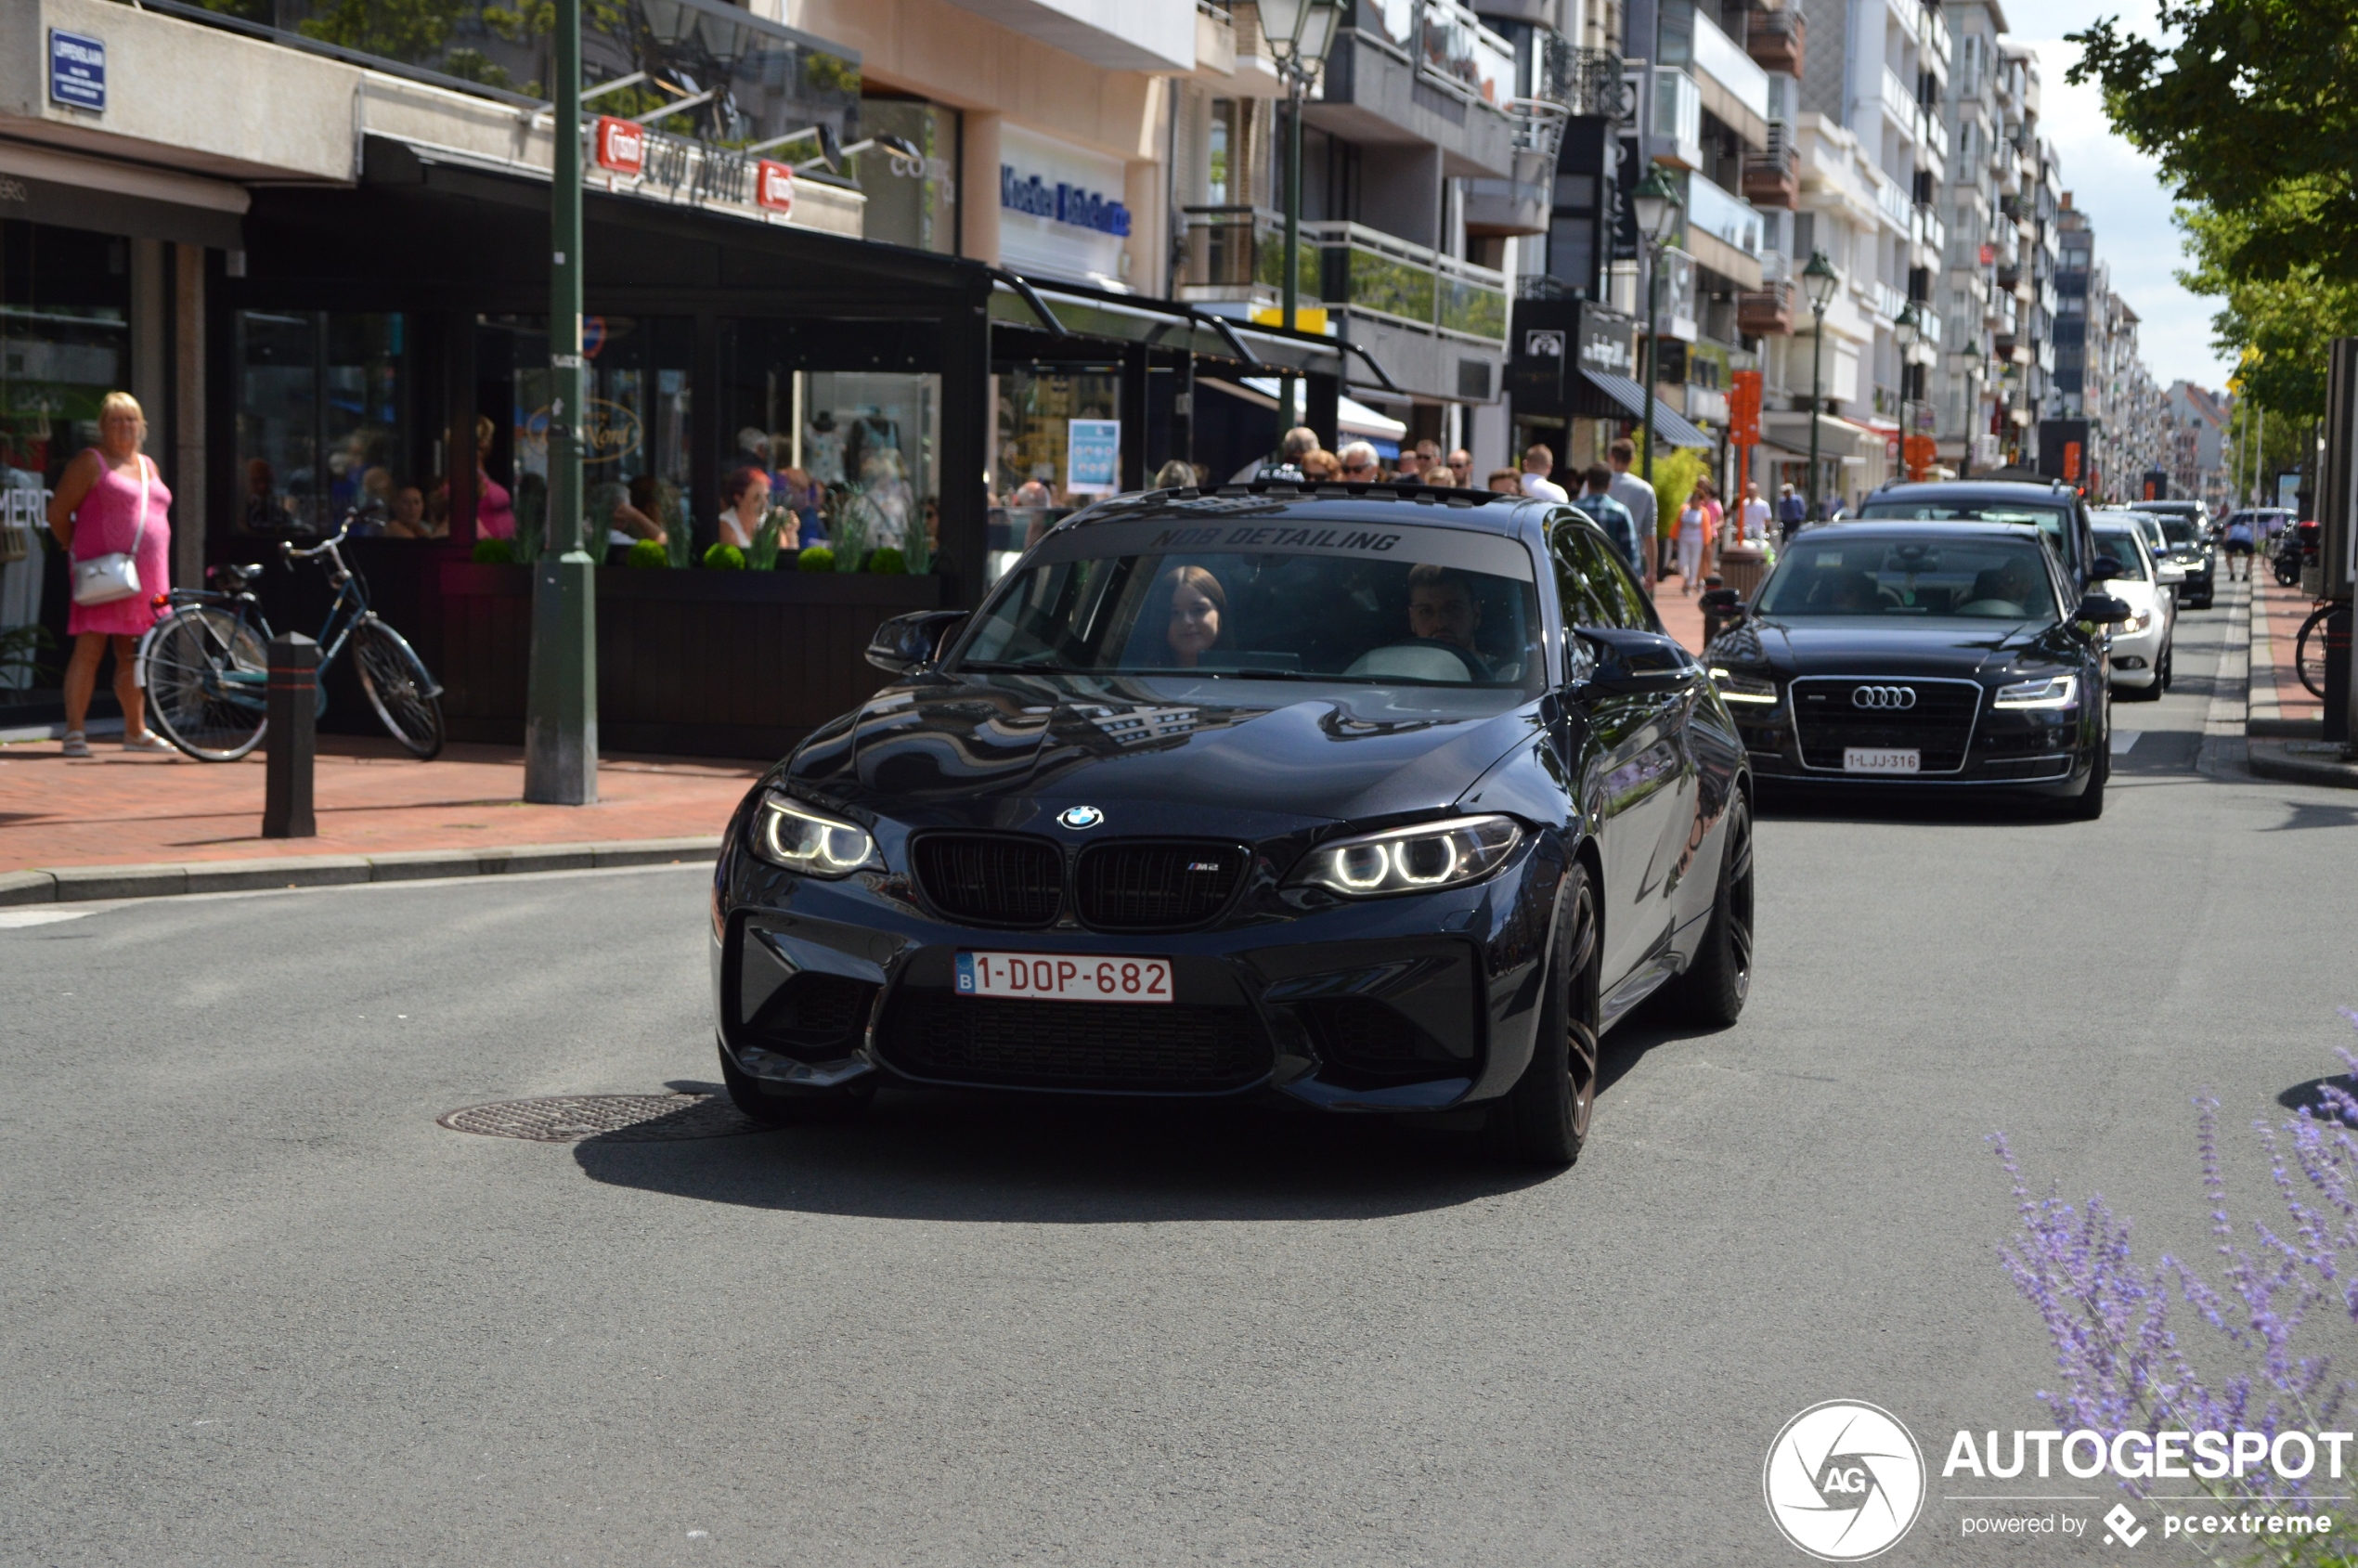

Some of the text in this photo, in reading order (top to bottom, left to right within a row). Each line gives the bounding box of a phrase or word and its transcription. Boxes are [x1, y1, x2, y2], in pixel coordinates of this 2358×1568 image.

[1226, 527, 1401, 551] DETAILING
[959, 956, 1167, 994] B 1-DOP-682
